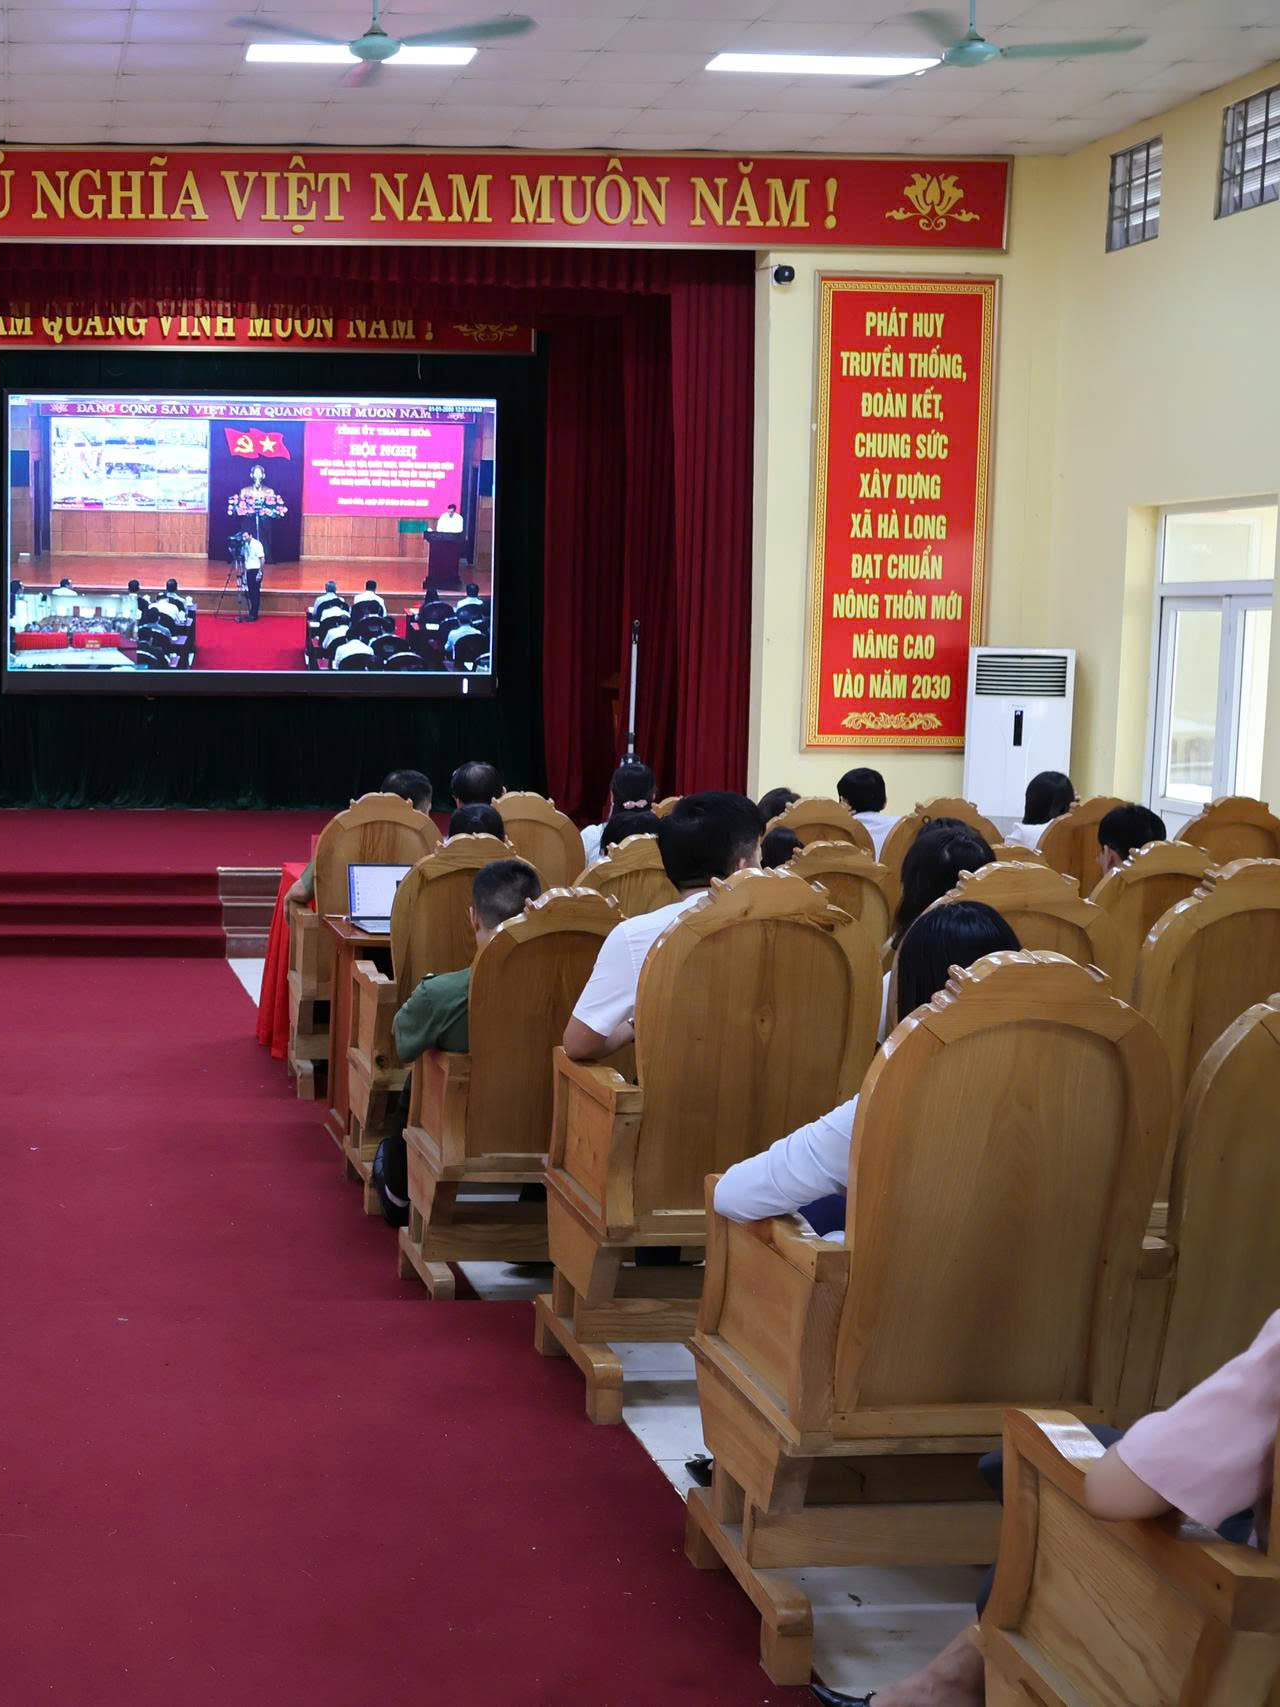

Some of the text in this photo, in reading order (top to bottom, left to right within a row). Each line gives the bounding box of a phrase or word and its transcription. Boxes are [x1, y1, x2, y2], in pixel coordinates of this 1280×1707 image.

[31, 156, 211, 220] NGHĨA
[220, 155, 351, 235] VIỆT
[369, 172, 493, 223] NAM
[509, 158, 671, 226] MUÔN
[689, 161, 810, 228] NĂM
[865, 306, 945, 338] PHÁT HUY
[840, 344, 967, 382] TRUYỀN THỐNG,
[861, 385, 944, 422] ĐOÀN KẾT,
[854, 429, 949, 460] CHUNG SỨC
[858, 468, 941, 505] XÂY DỰNG
[850, 508, 947, 540] XÃ HÀ LONG
[851, 544, 943, 585] ĐẠT CHUẨN
[832, 588, 963, 620] NÔNG THÔN MỚI
[852, 628, 936, 660] NÂNG CAO
[832, 668, 951, 700] VÀO NĂM 2030
